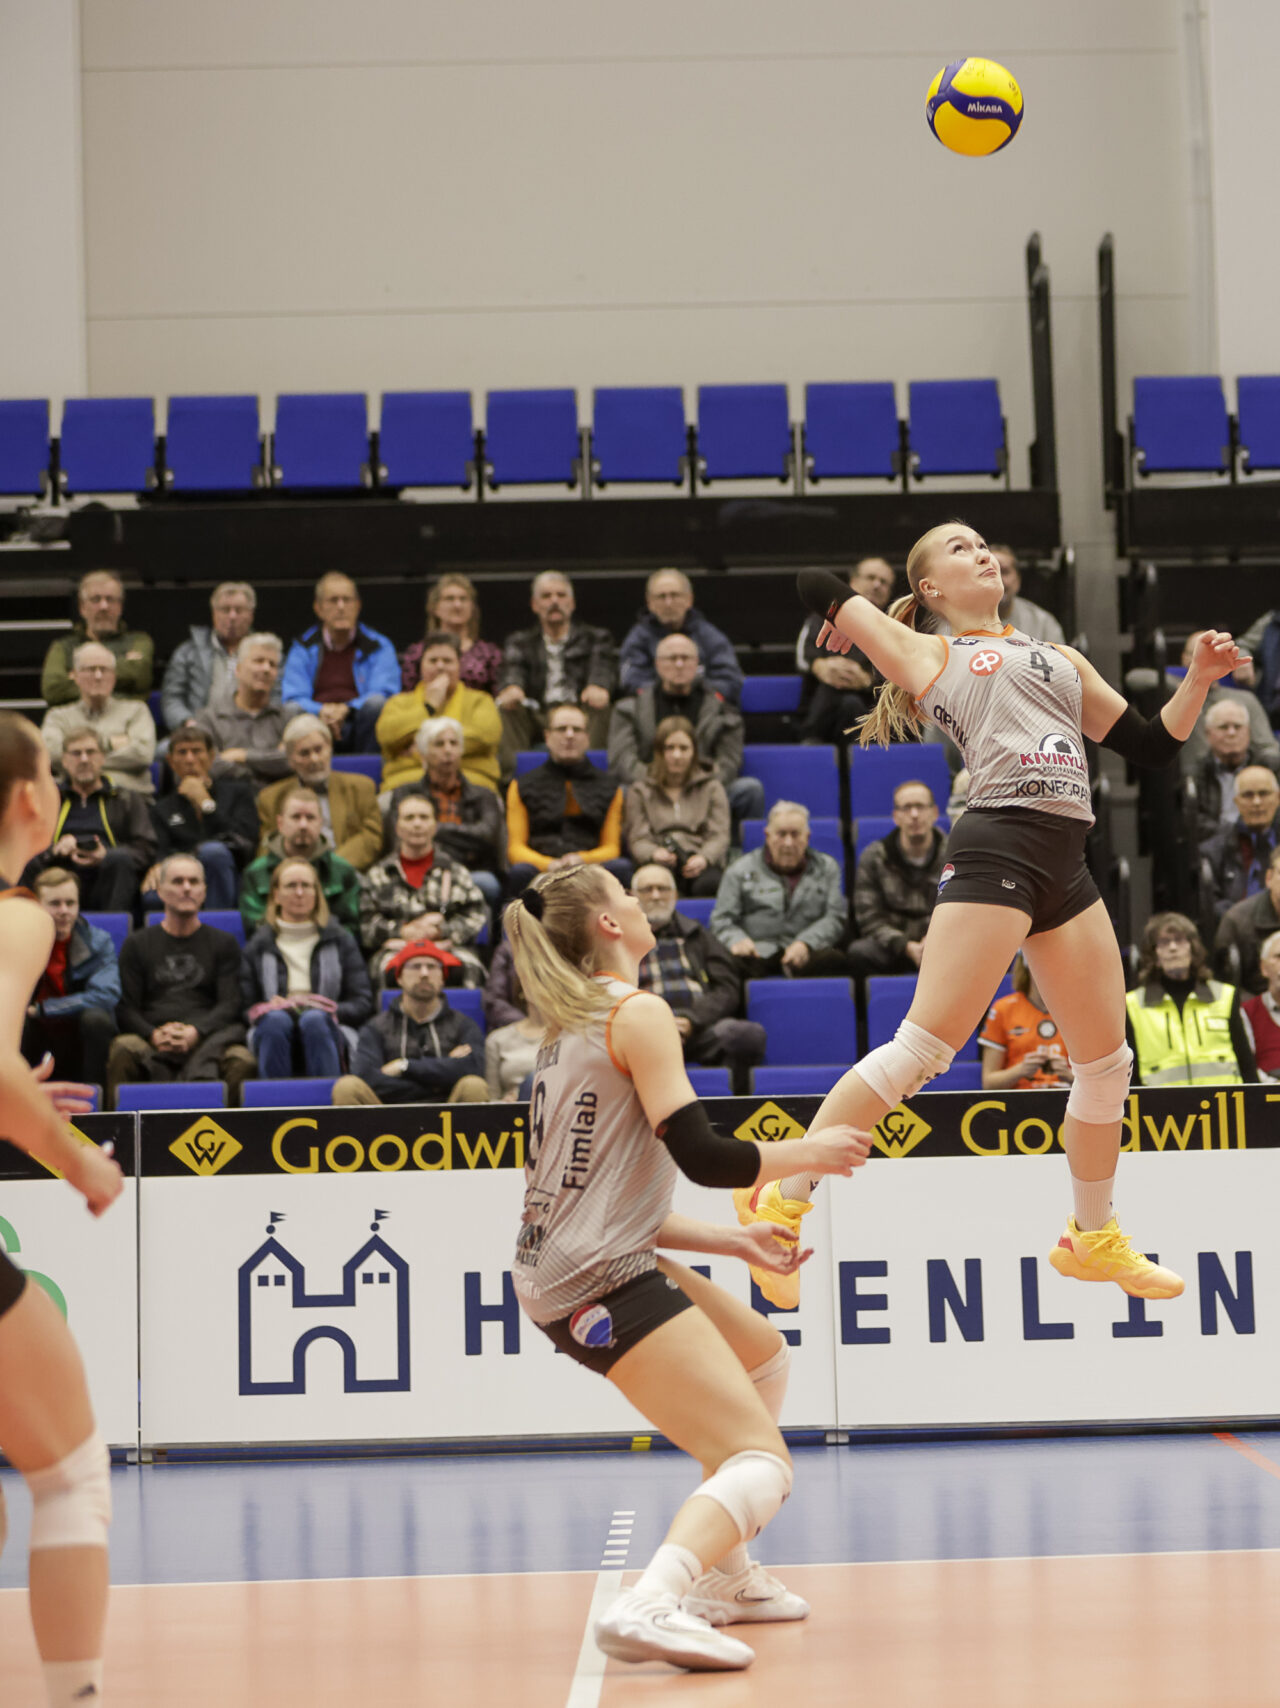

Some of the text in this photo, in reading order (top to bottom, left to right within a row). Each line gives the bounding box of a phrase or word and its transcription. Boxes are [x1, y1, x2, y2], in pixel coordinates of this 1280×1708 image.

[1030, 651, 1053, 682] 4
[271, 1112, 526, 1174] Goodwi
[561, 1091, 598, 1190] Fimlab
[960, 1091, 1247, 1157] Godwill
